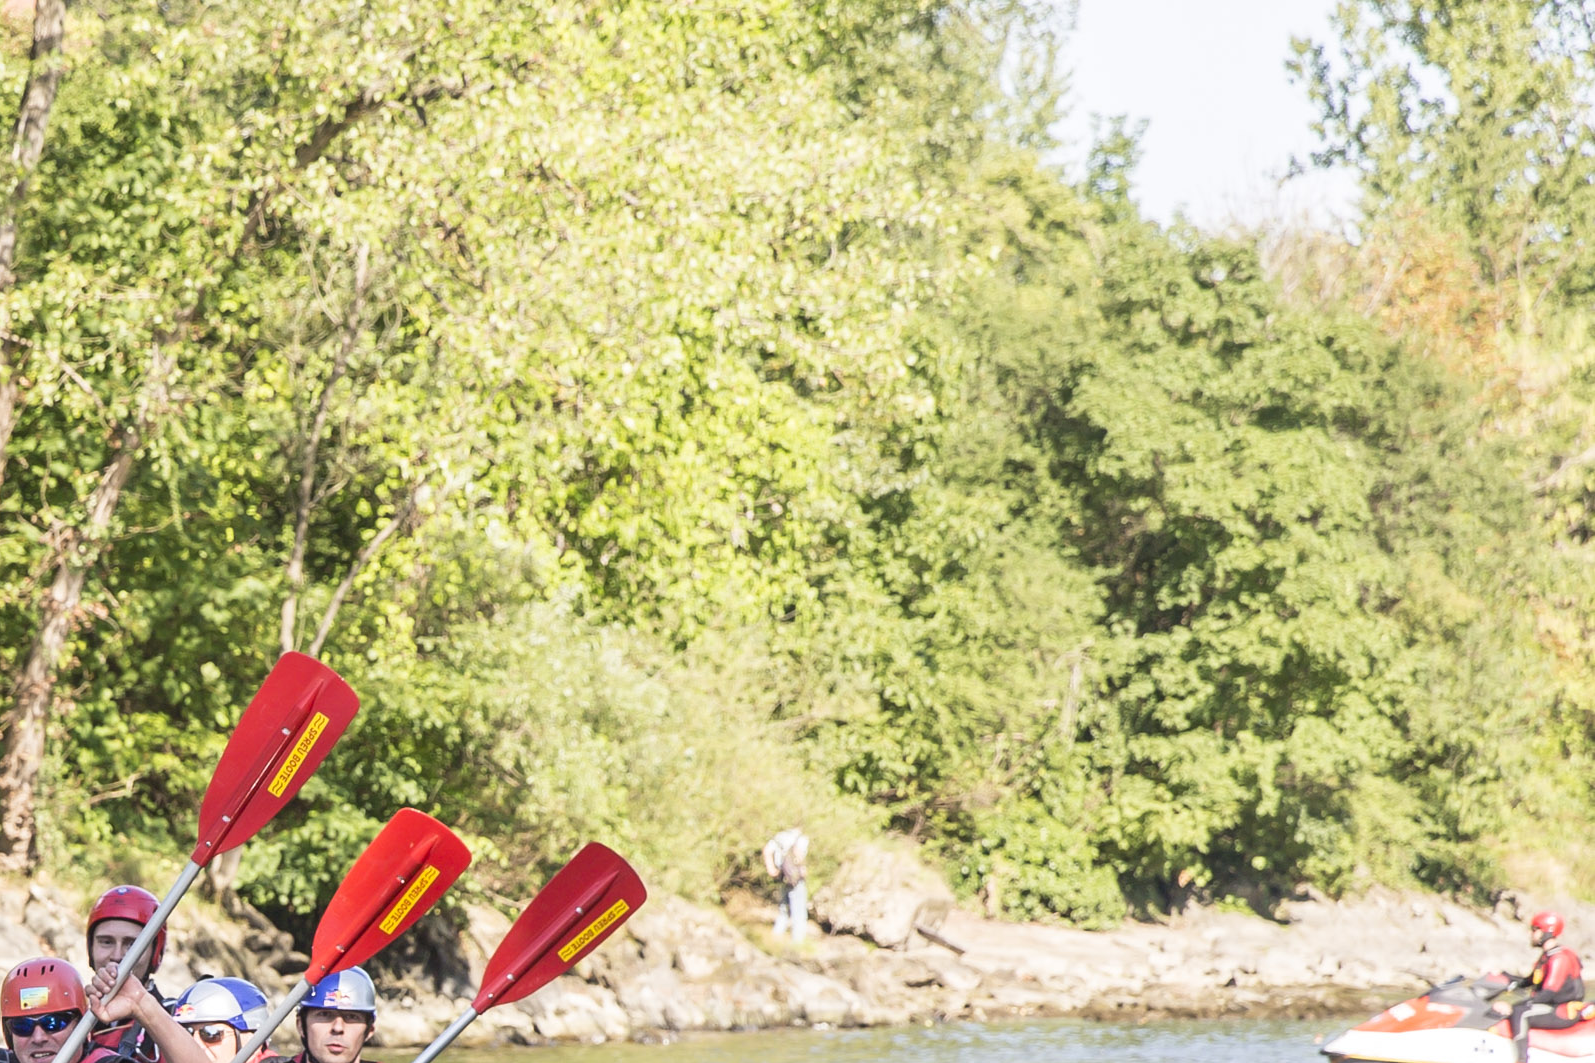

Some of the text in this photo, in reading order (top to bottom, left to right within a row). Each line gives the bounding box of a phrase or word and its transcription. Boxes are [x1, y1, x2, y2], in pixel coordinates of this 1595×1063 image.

[280, 727, 318, 782] SPREU BOOTE
[390, 878, 429, 922] SPREU BOOTE
[570, 928, 594, 952] BOOTE
